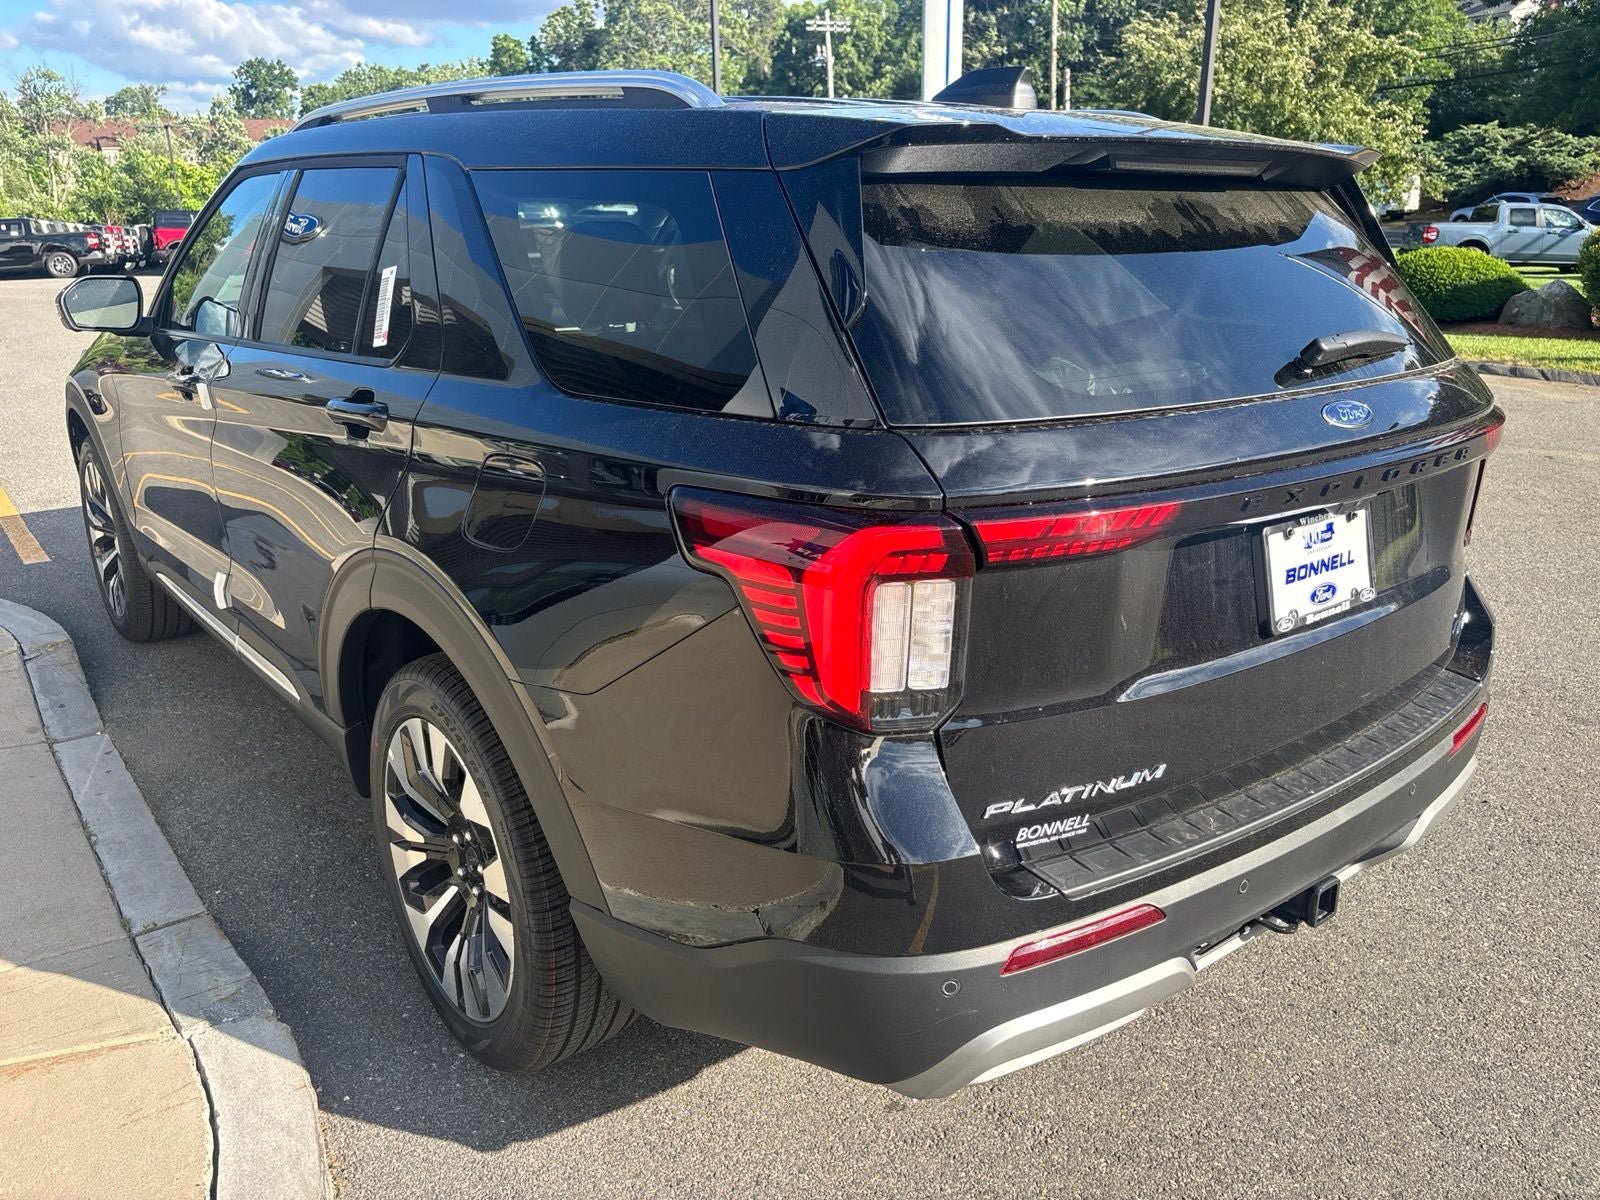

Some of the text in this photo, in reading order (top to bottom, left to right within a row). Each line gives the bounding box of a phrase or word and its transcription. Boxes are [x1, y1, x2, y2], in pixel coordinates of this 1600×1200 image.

[1331, 402, 1369, 423] Ford
[1240, 446, 1469, 512] EXPLORER
[1285, 549, 1355, 585] BONNELL
[1312, 584, 1337, 604] Ford
[1305, 600, 1351, 625] Bonnell
[982, 763, 1167, 819] PLATINUM
[1015, 813, 1090, 842] BONNELL
